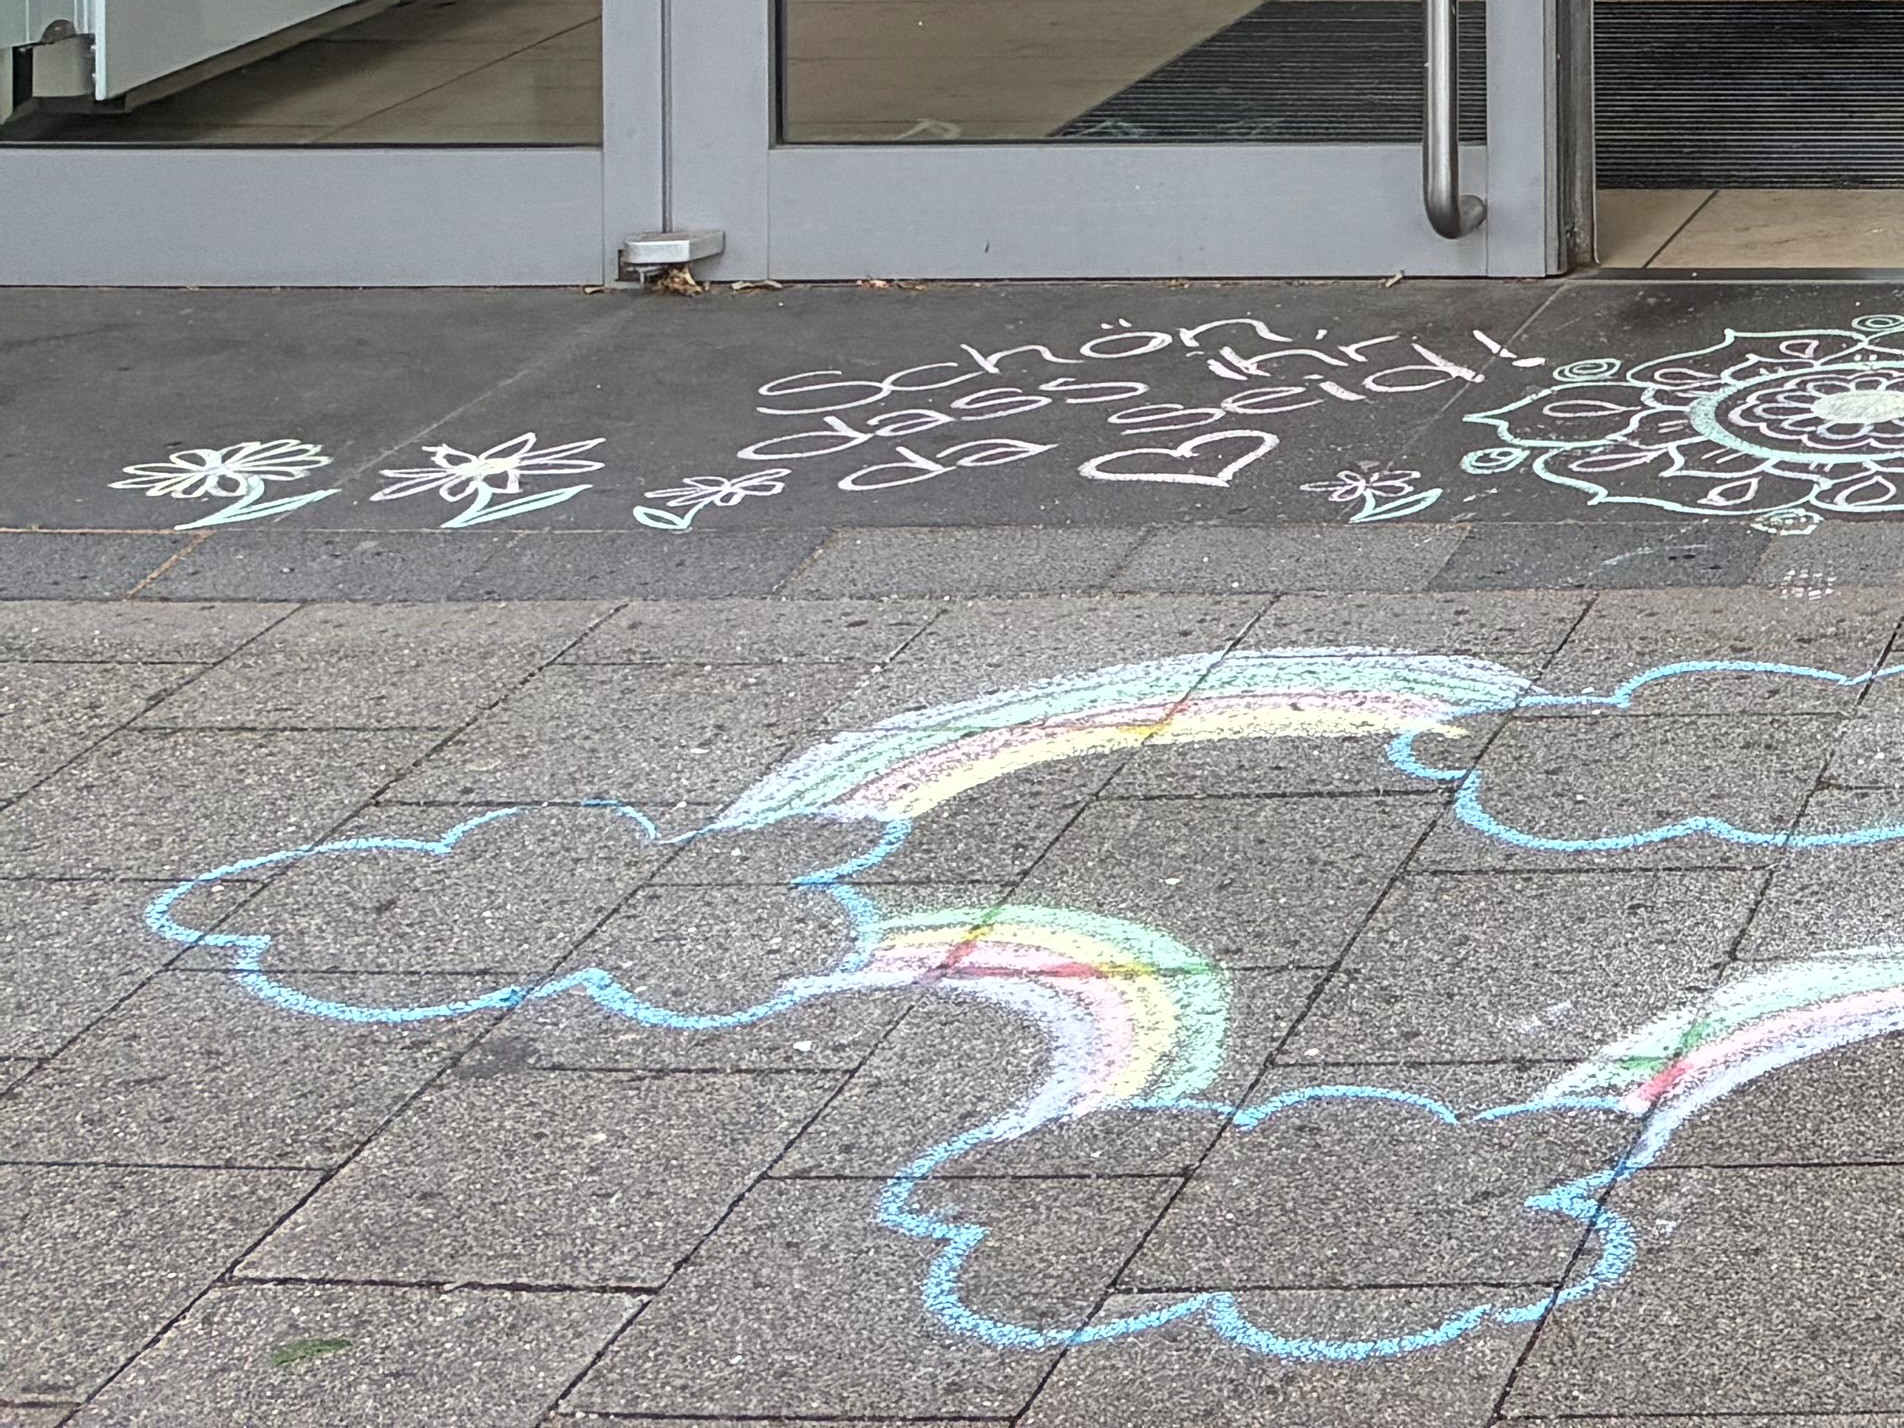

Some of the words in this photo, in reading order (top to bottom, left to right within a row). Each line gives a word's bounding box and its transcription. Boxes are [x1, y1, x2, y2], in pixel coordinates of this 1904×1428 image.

[735, 376, 1150, 461] dass
[1186, 334, 1400, 382] ihr
[838, 439, 1061, 491] da
[1107, 329, 1546, 437] seid!
